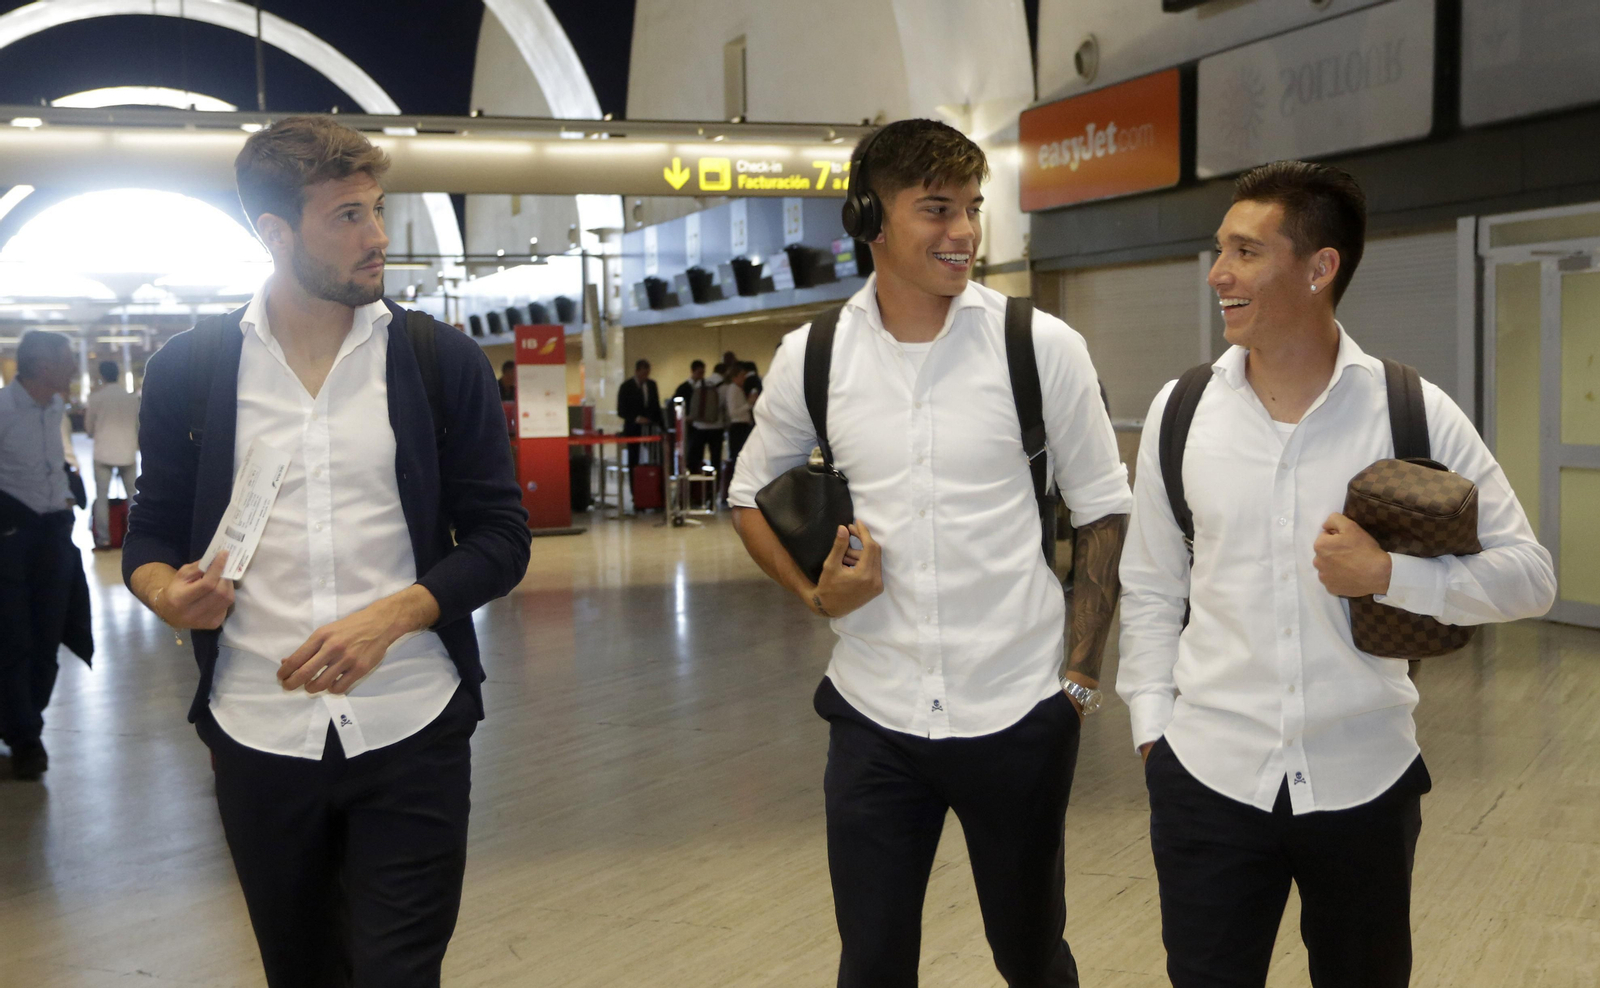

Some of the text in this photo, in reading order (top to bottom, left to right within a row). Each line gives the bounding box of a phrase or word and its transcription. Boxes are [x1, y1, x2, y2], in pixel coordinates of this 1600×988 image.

[735, 160, 782, 173] Check-in
[738, 175, 810, 190] Facturación
[812, 161, 830, 190] 7
[521, 338, 538, 349] IB
